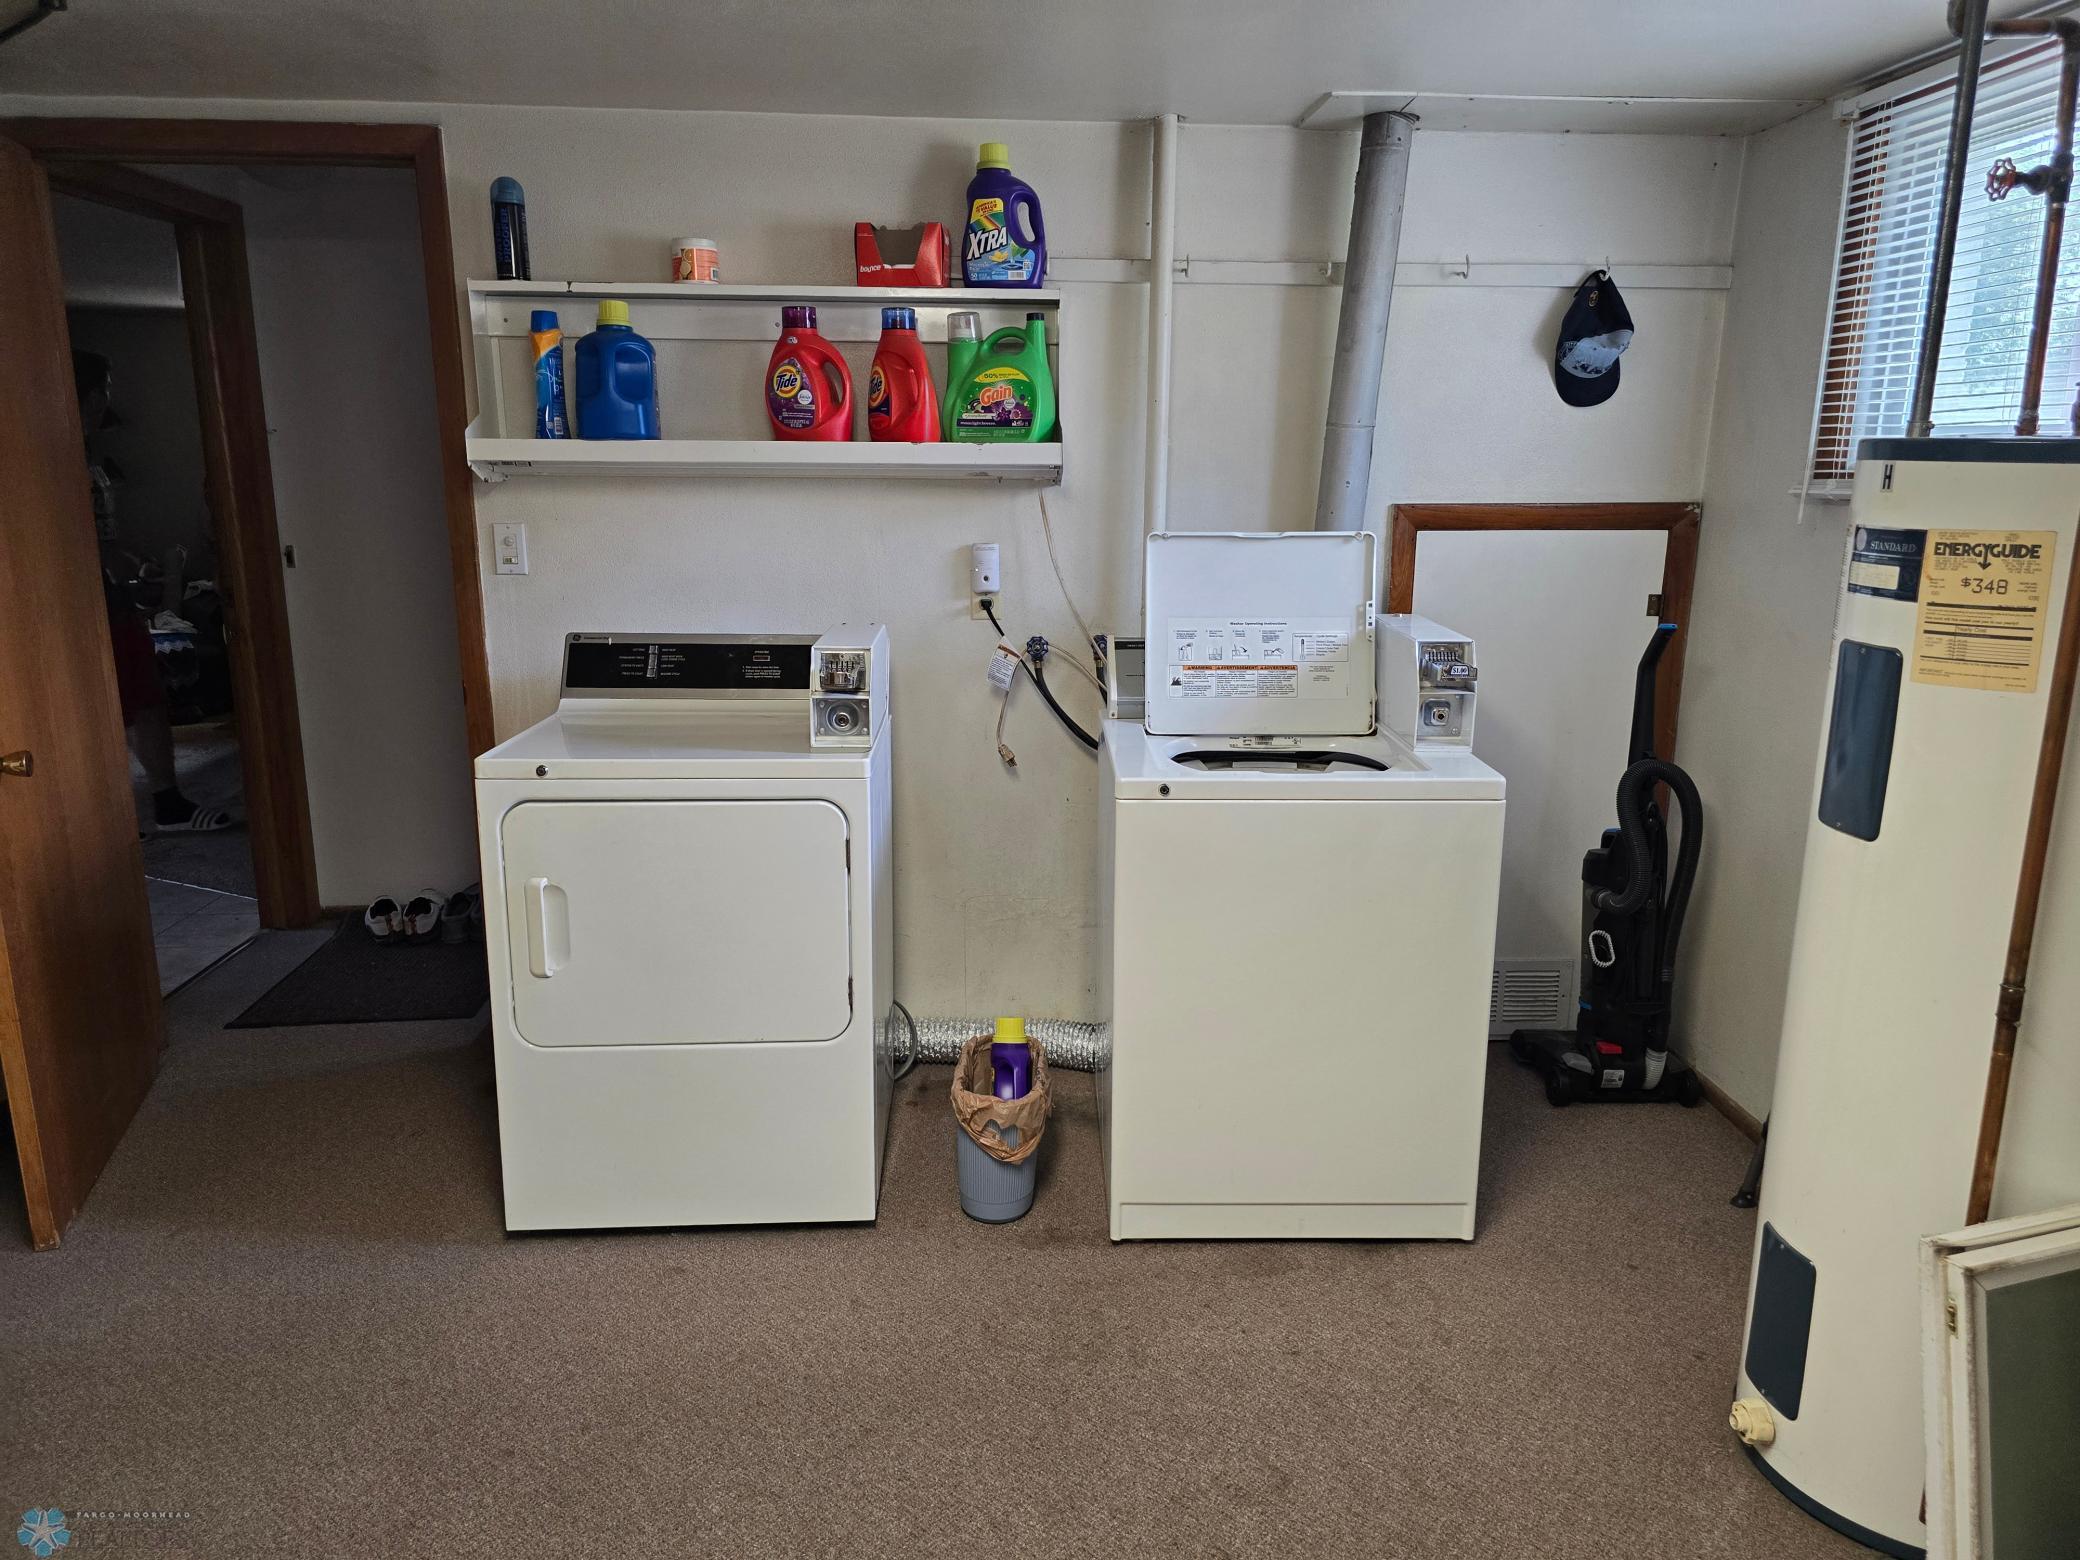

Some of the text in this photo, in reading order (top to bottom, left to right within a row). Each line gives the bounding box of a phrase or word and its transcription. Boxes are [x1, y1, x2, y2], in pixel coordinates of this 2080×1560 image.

[966, 226, 1007, 260] XTRA
[860, 264, 881, 272] bounce
[777, 373, 797, 391] Tide
[980, 386, 1012, 406] Gain
[1870, 541, 1918, 553] STANDARD
[1934, 541, 2042, 561] ENERGYGUIDE
[1961, 577, 2008, 594] $348
